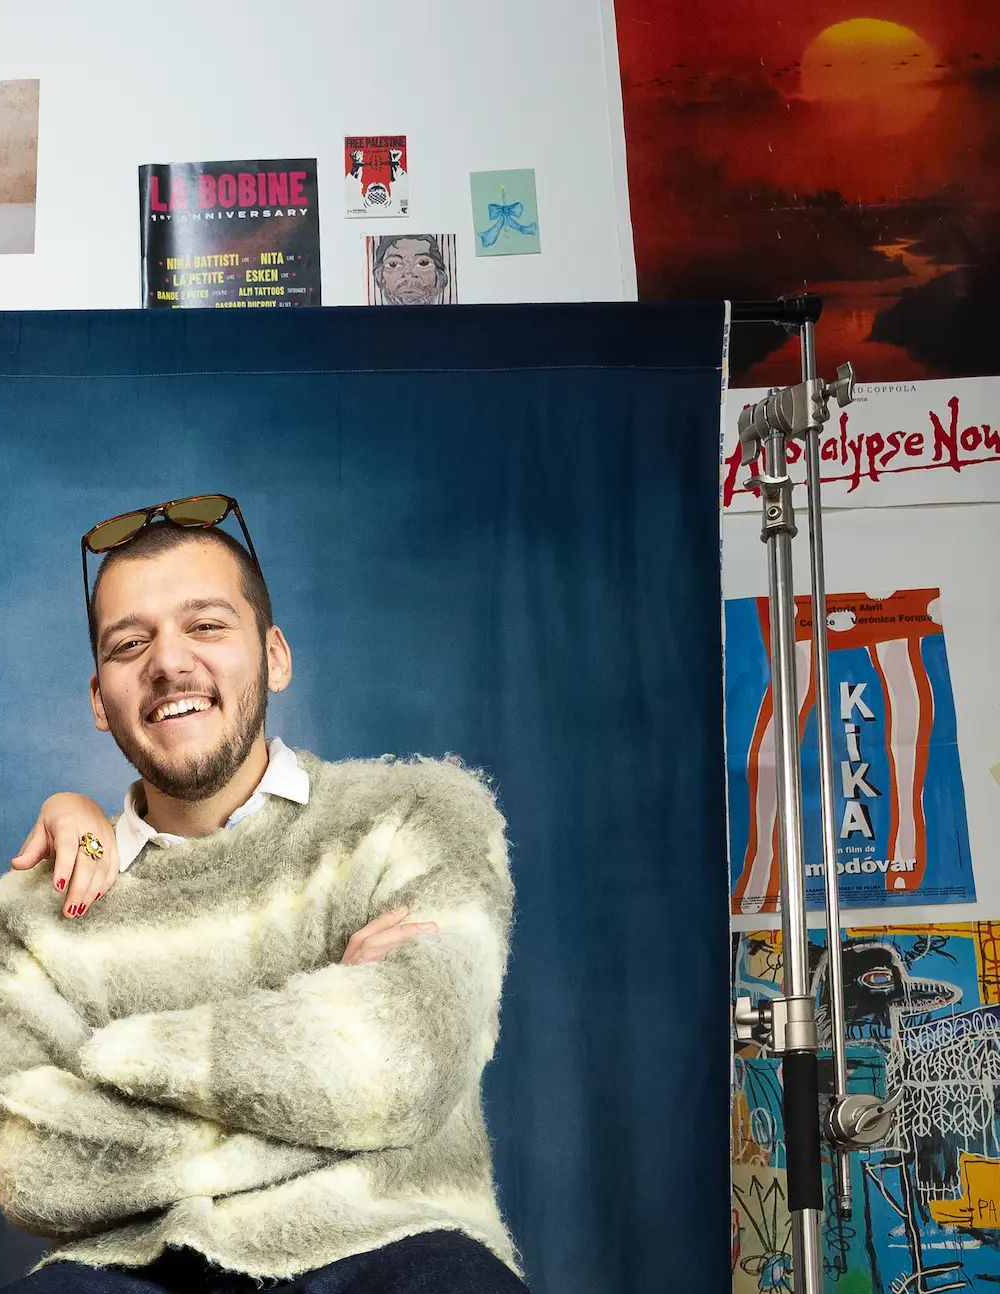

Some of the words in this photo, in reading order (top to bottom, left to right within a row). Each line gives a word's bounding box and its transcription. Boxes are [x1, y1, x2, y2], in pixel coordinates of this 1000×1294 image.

[347, 138, 364, 148] FREE
[366, 136, 404, 148] PALESTINE
[151, 176, 188, 212] LA
[198, 171, 308, 209] BOBINE
[177, 208, 309, 222] ANNIVERSARY
[166, 257, 191, 270] NINA
[194, 253, 239, 269] BATTISTI
[260, 252, 284, 265] NITA
[173, 274, 186, 286] LA
[189, 271, 224, 285] PETITE
[245, 269, 279, 282] ESKEN
[157, 290, 179, 301] BANDE
[254, 286, 285, 296] TATTOOS
[867, 385, 917, 393] COPPOLA
[859, 602, 883, 612] Abril
[845, 846, 862, 854] film
